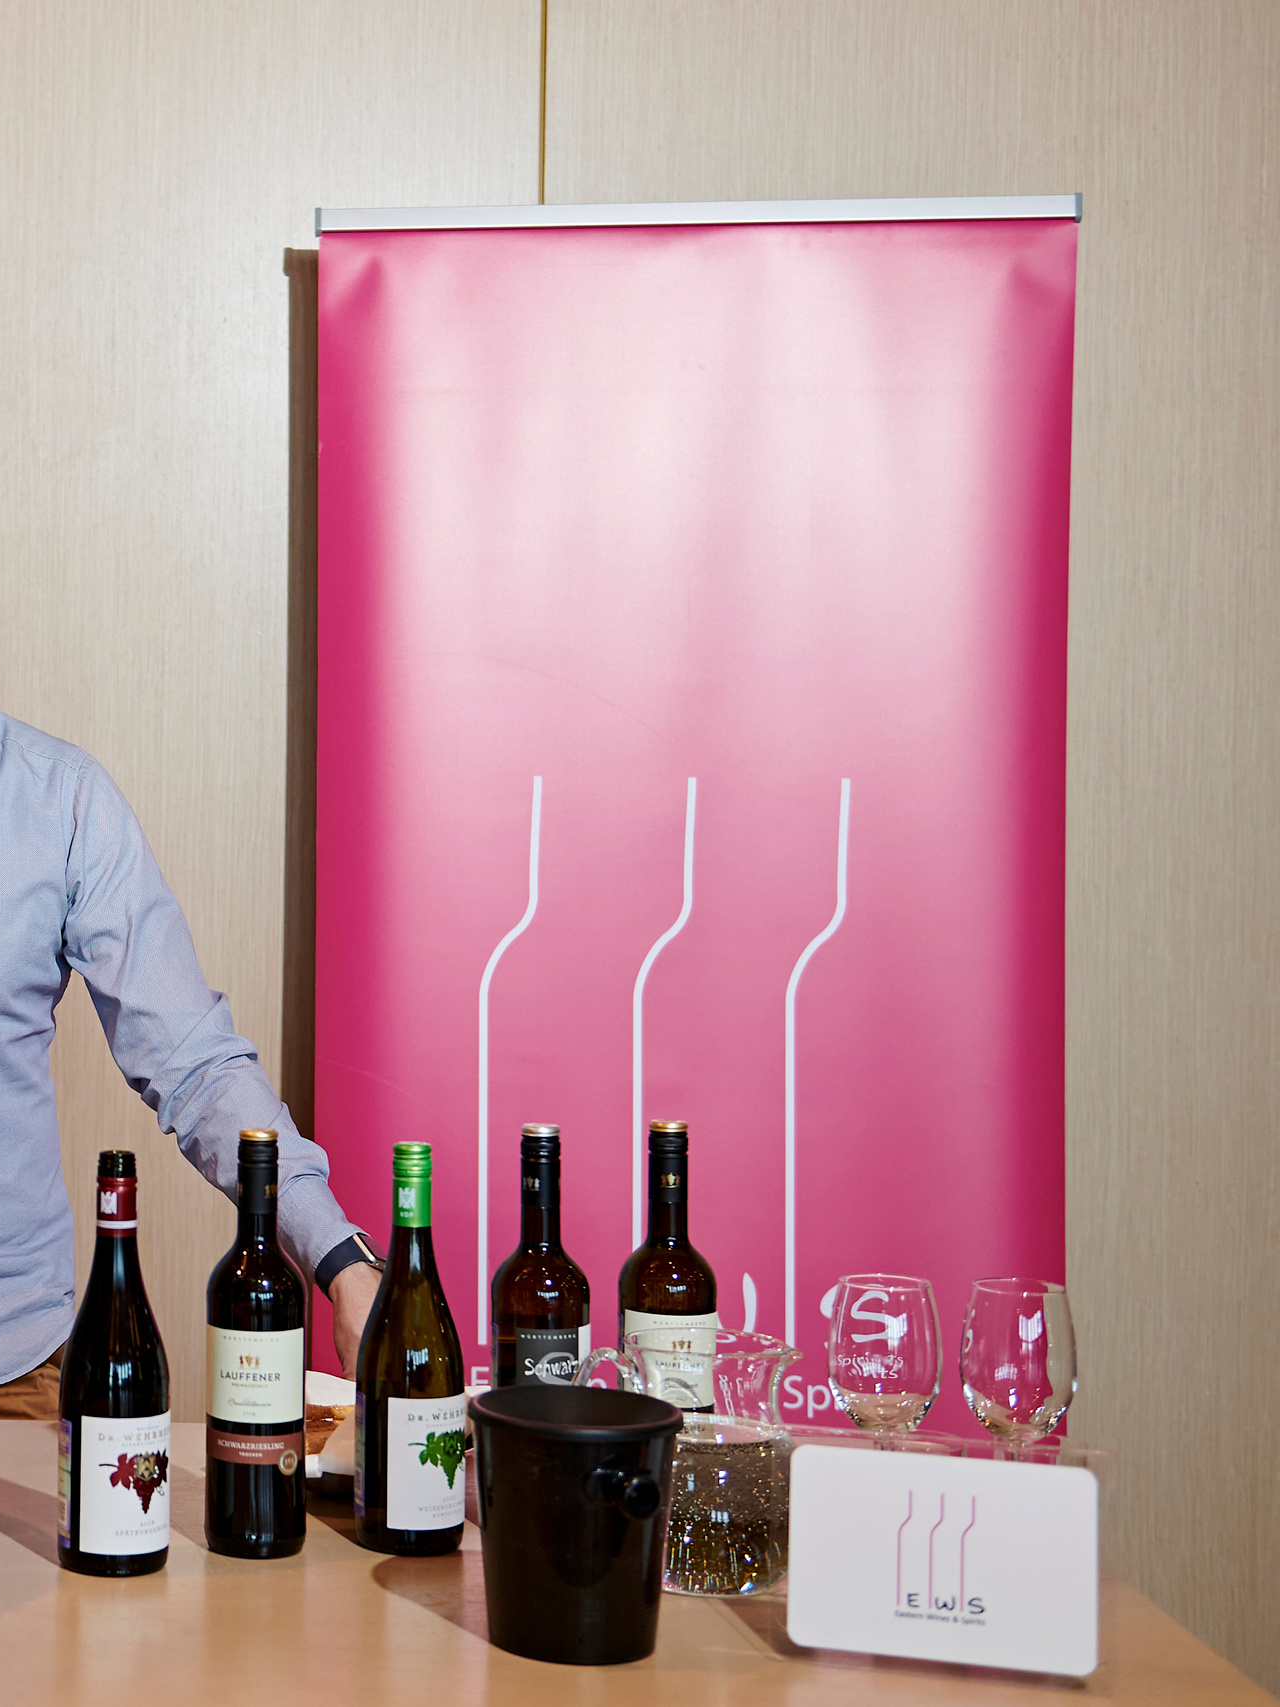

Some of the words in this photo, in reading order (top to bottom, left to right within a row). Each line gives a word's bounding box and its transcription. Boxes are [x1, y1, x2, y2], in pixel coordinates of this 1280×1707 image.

[524, 1357, 581, 1378] Schwarz
[220, 1369, 281, 1382] LAUFFENER
[217, 1439, 285, 1451] SCHWARZRIESLING
[894, 1609, 924, 1619] Eastern
[926, 1612, 950, 1622] Wines
[961, 1617, 986, 1627] Spirits
